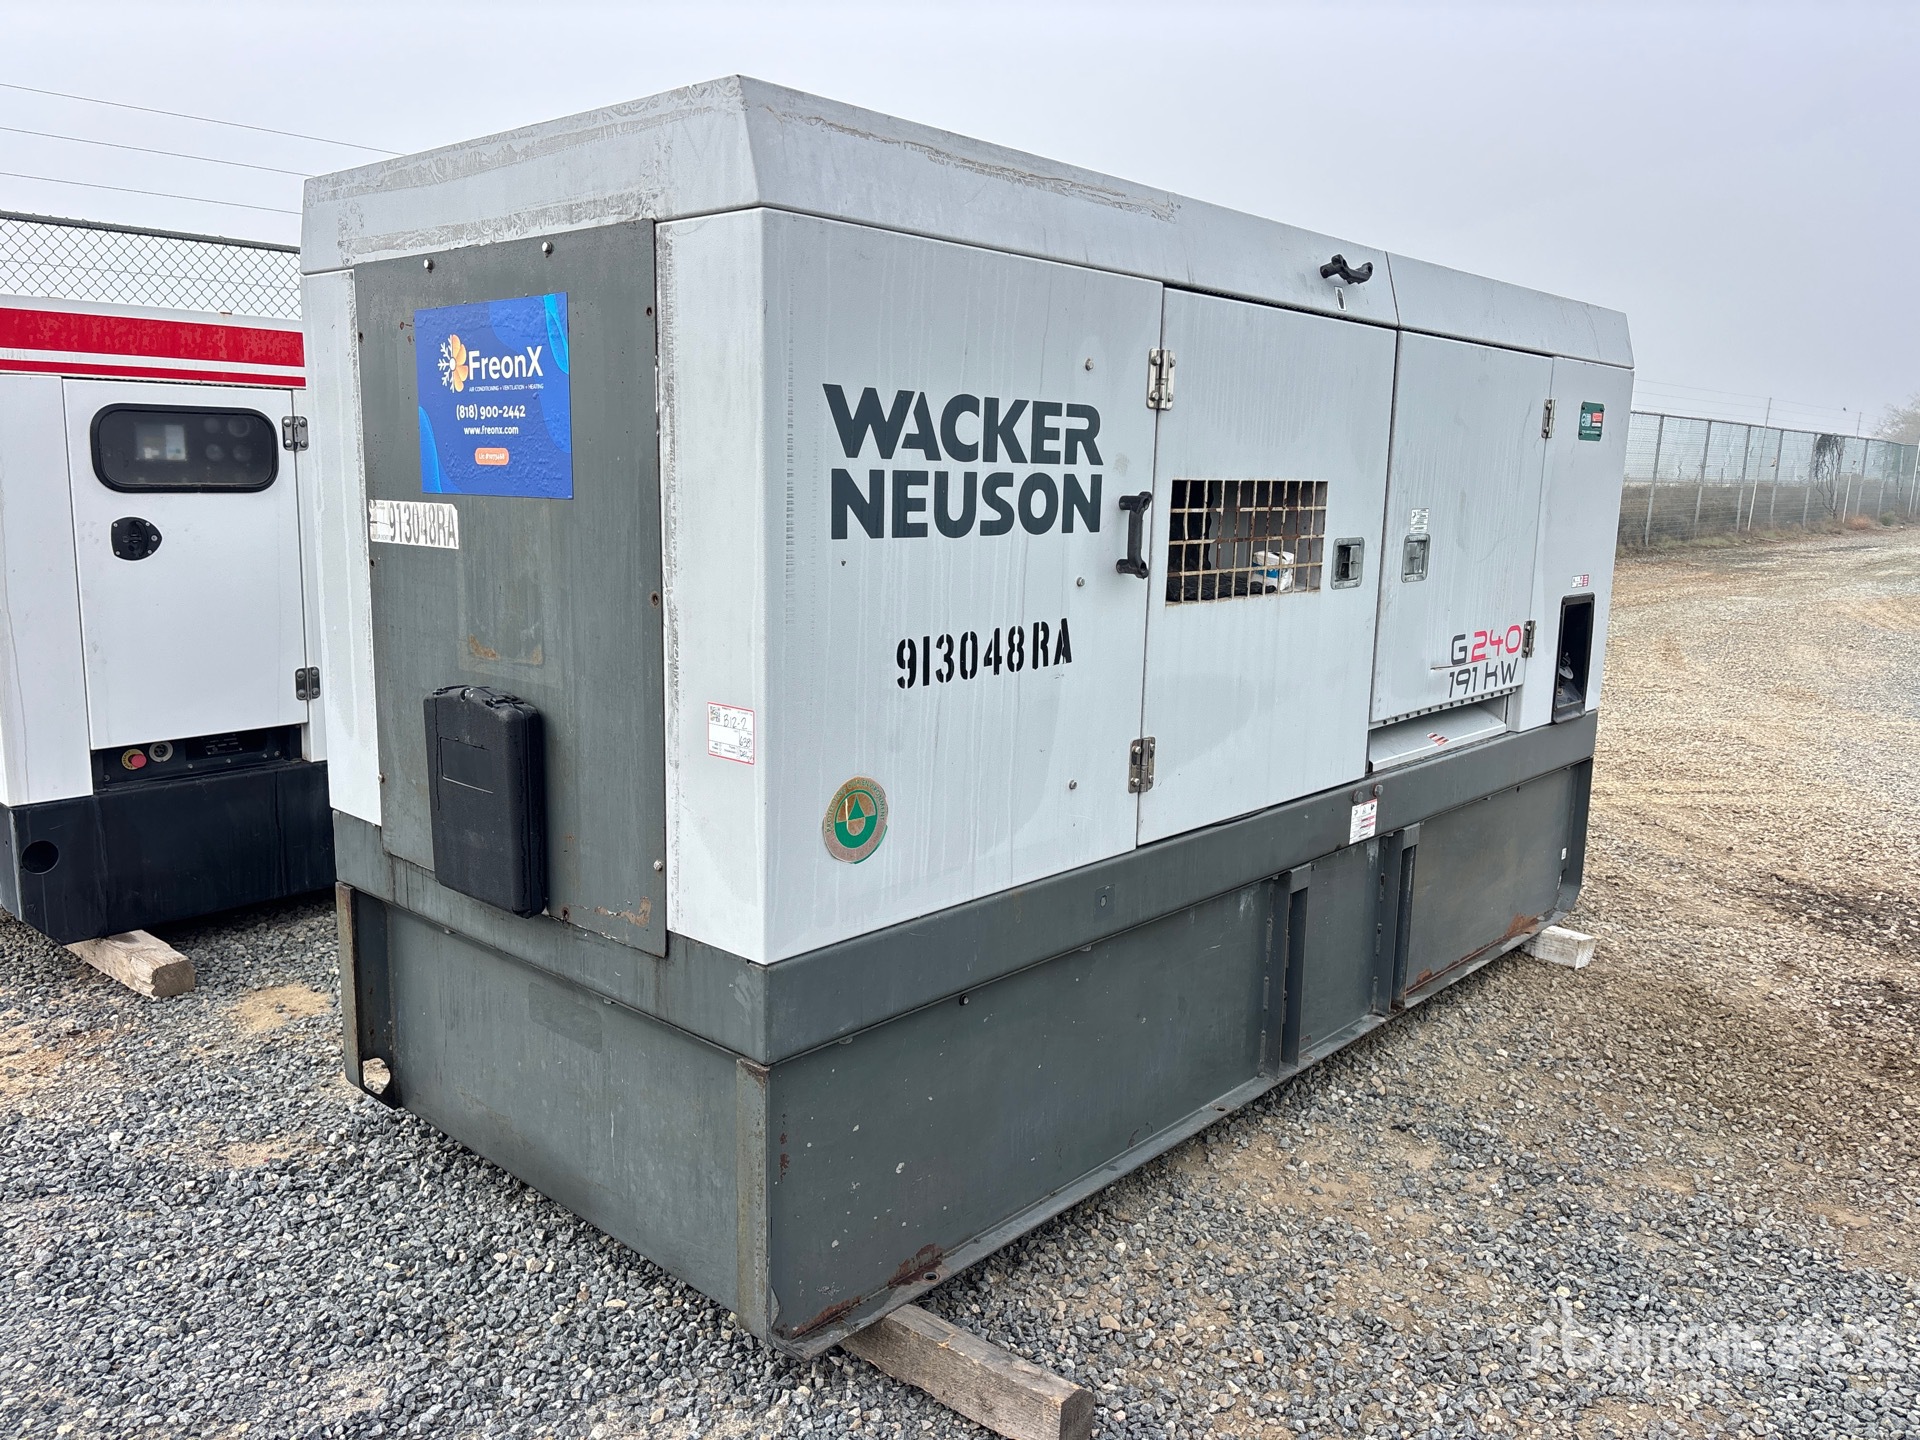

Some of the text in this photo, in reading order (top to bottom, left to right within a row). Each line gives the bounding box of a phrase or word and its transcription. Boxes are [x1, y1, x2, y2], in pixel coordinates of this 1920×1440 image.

[468, 345, 544, 380] FreonX
[456, 403, 526, 421] (818) 900-2442
[463, 424, 519, 435] www.freonx.com
[822, 383, 1104, 466] WACKER
[389, 501, 457, 547] 913048RA
[831, 468, 1103, 540] NEUSON
[896, 617, 1073, 690] 913048RA
[1450, 624, 1522, 666] G240
[1448, 666, 1478, 699] 191
